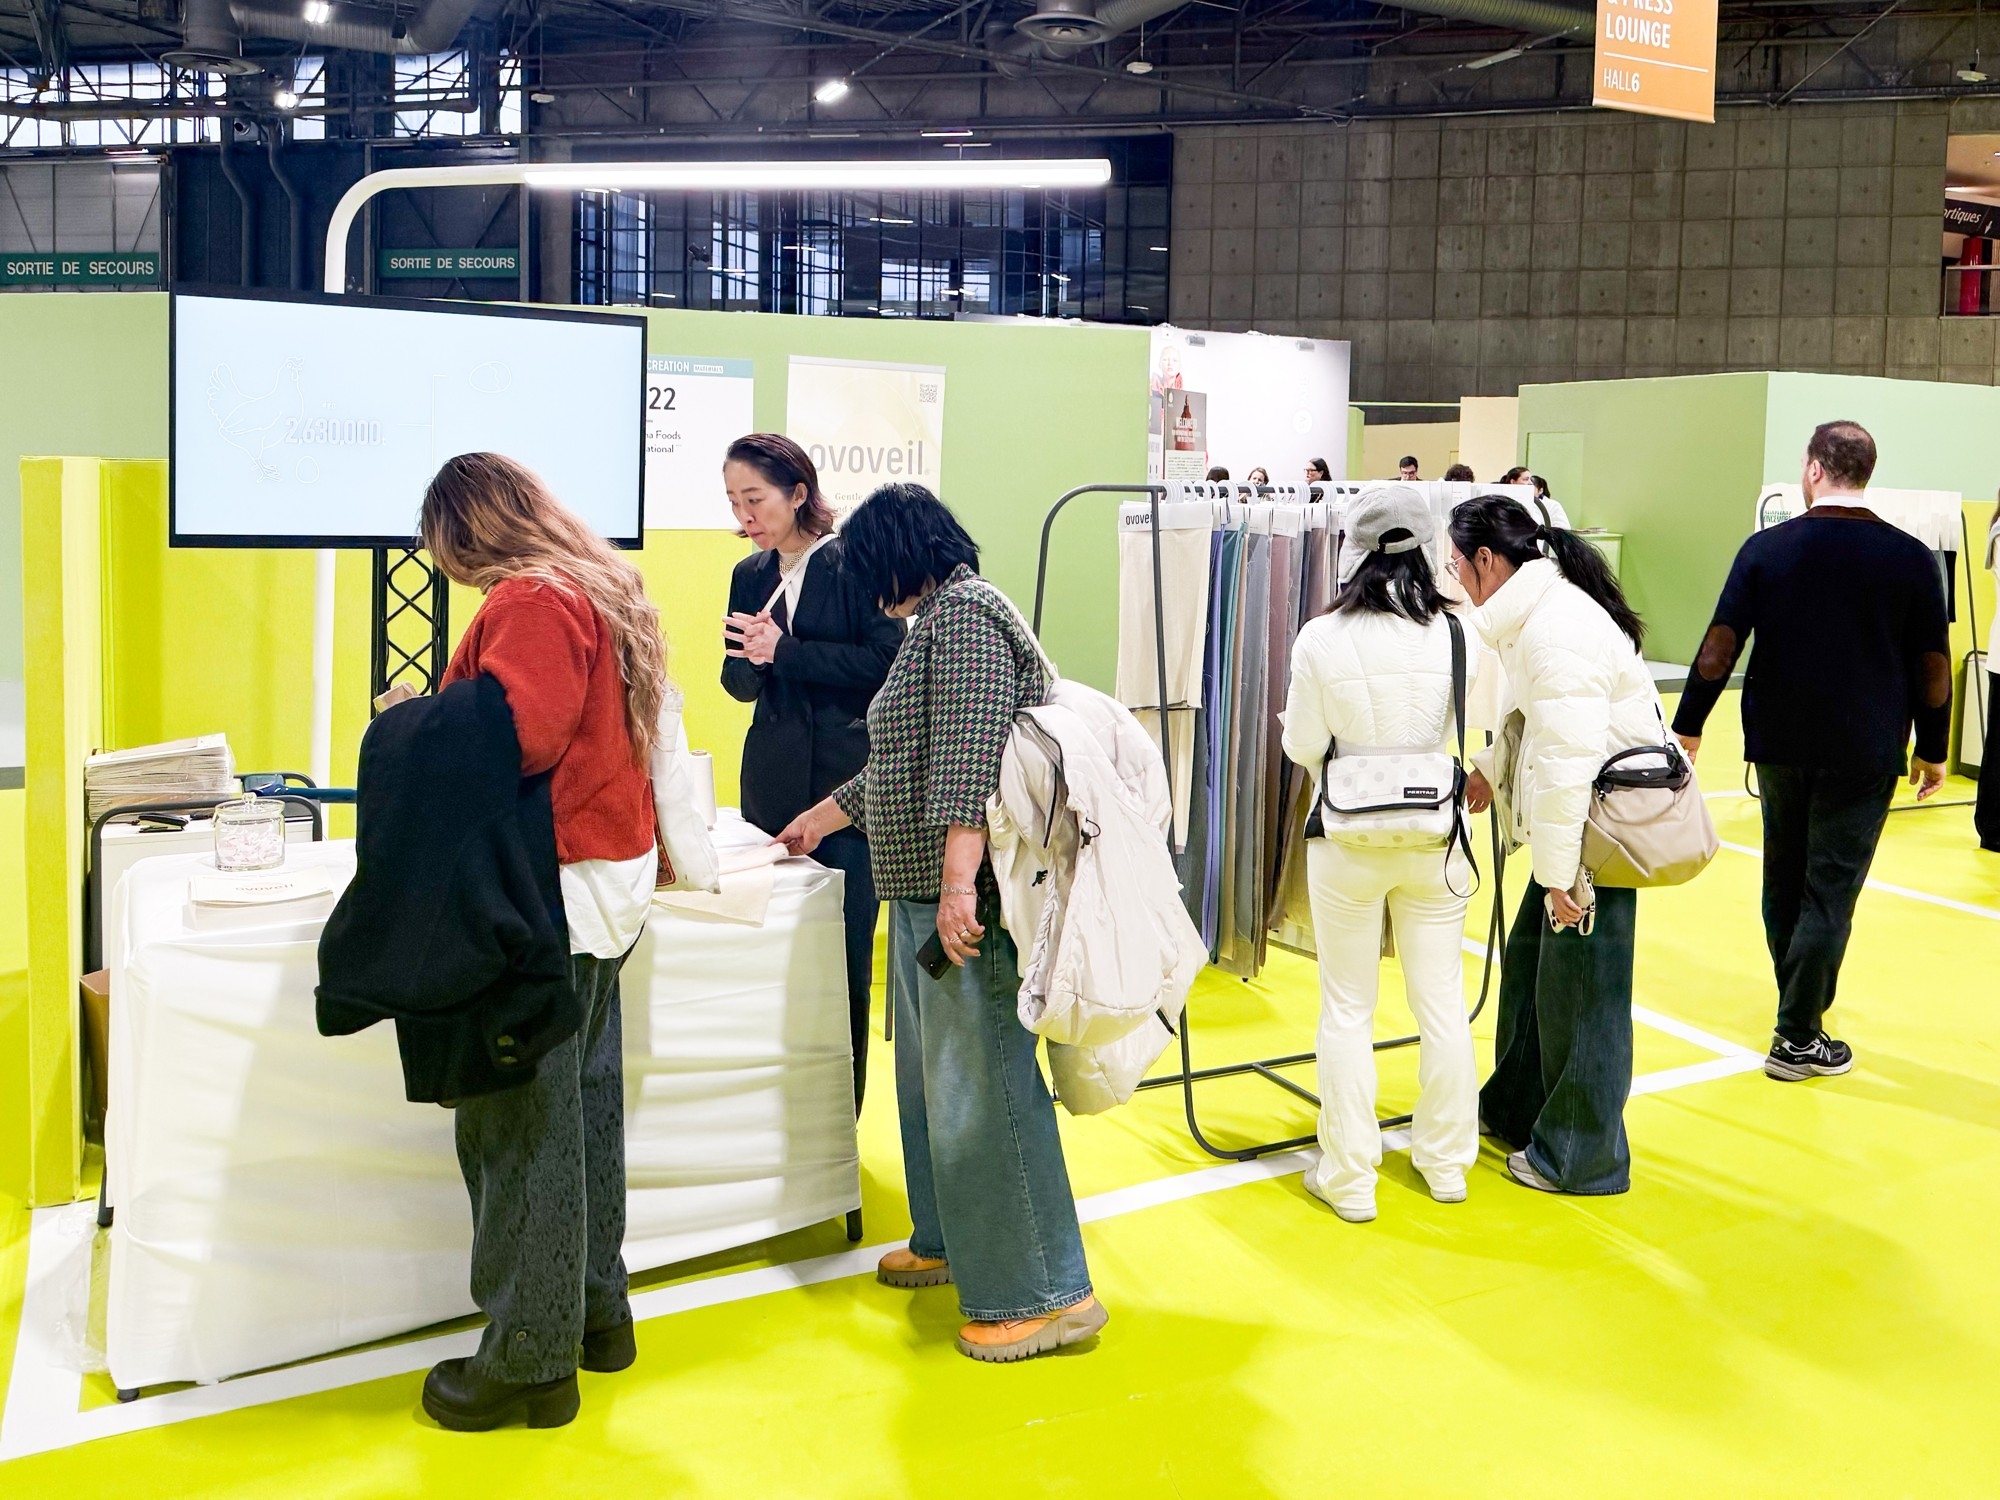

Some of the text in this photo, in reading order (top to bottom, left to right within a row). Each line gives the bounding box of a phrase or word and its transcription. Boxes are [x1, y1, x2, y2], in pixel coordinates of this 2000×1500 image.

[1605, 12, 1671, 48] LOUNGE
[1603, 67, 1640, 93] HALL6
[7, 261, 154, 275] SORTIE DE SECOURS
[390, 257, 515, 269] SORTIE DE SECOURS
[655, 430, 682, 440] Foods
[808, 440, 923, 475] ovoveil
[835, 492, 863, 501] Gentle
